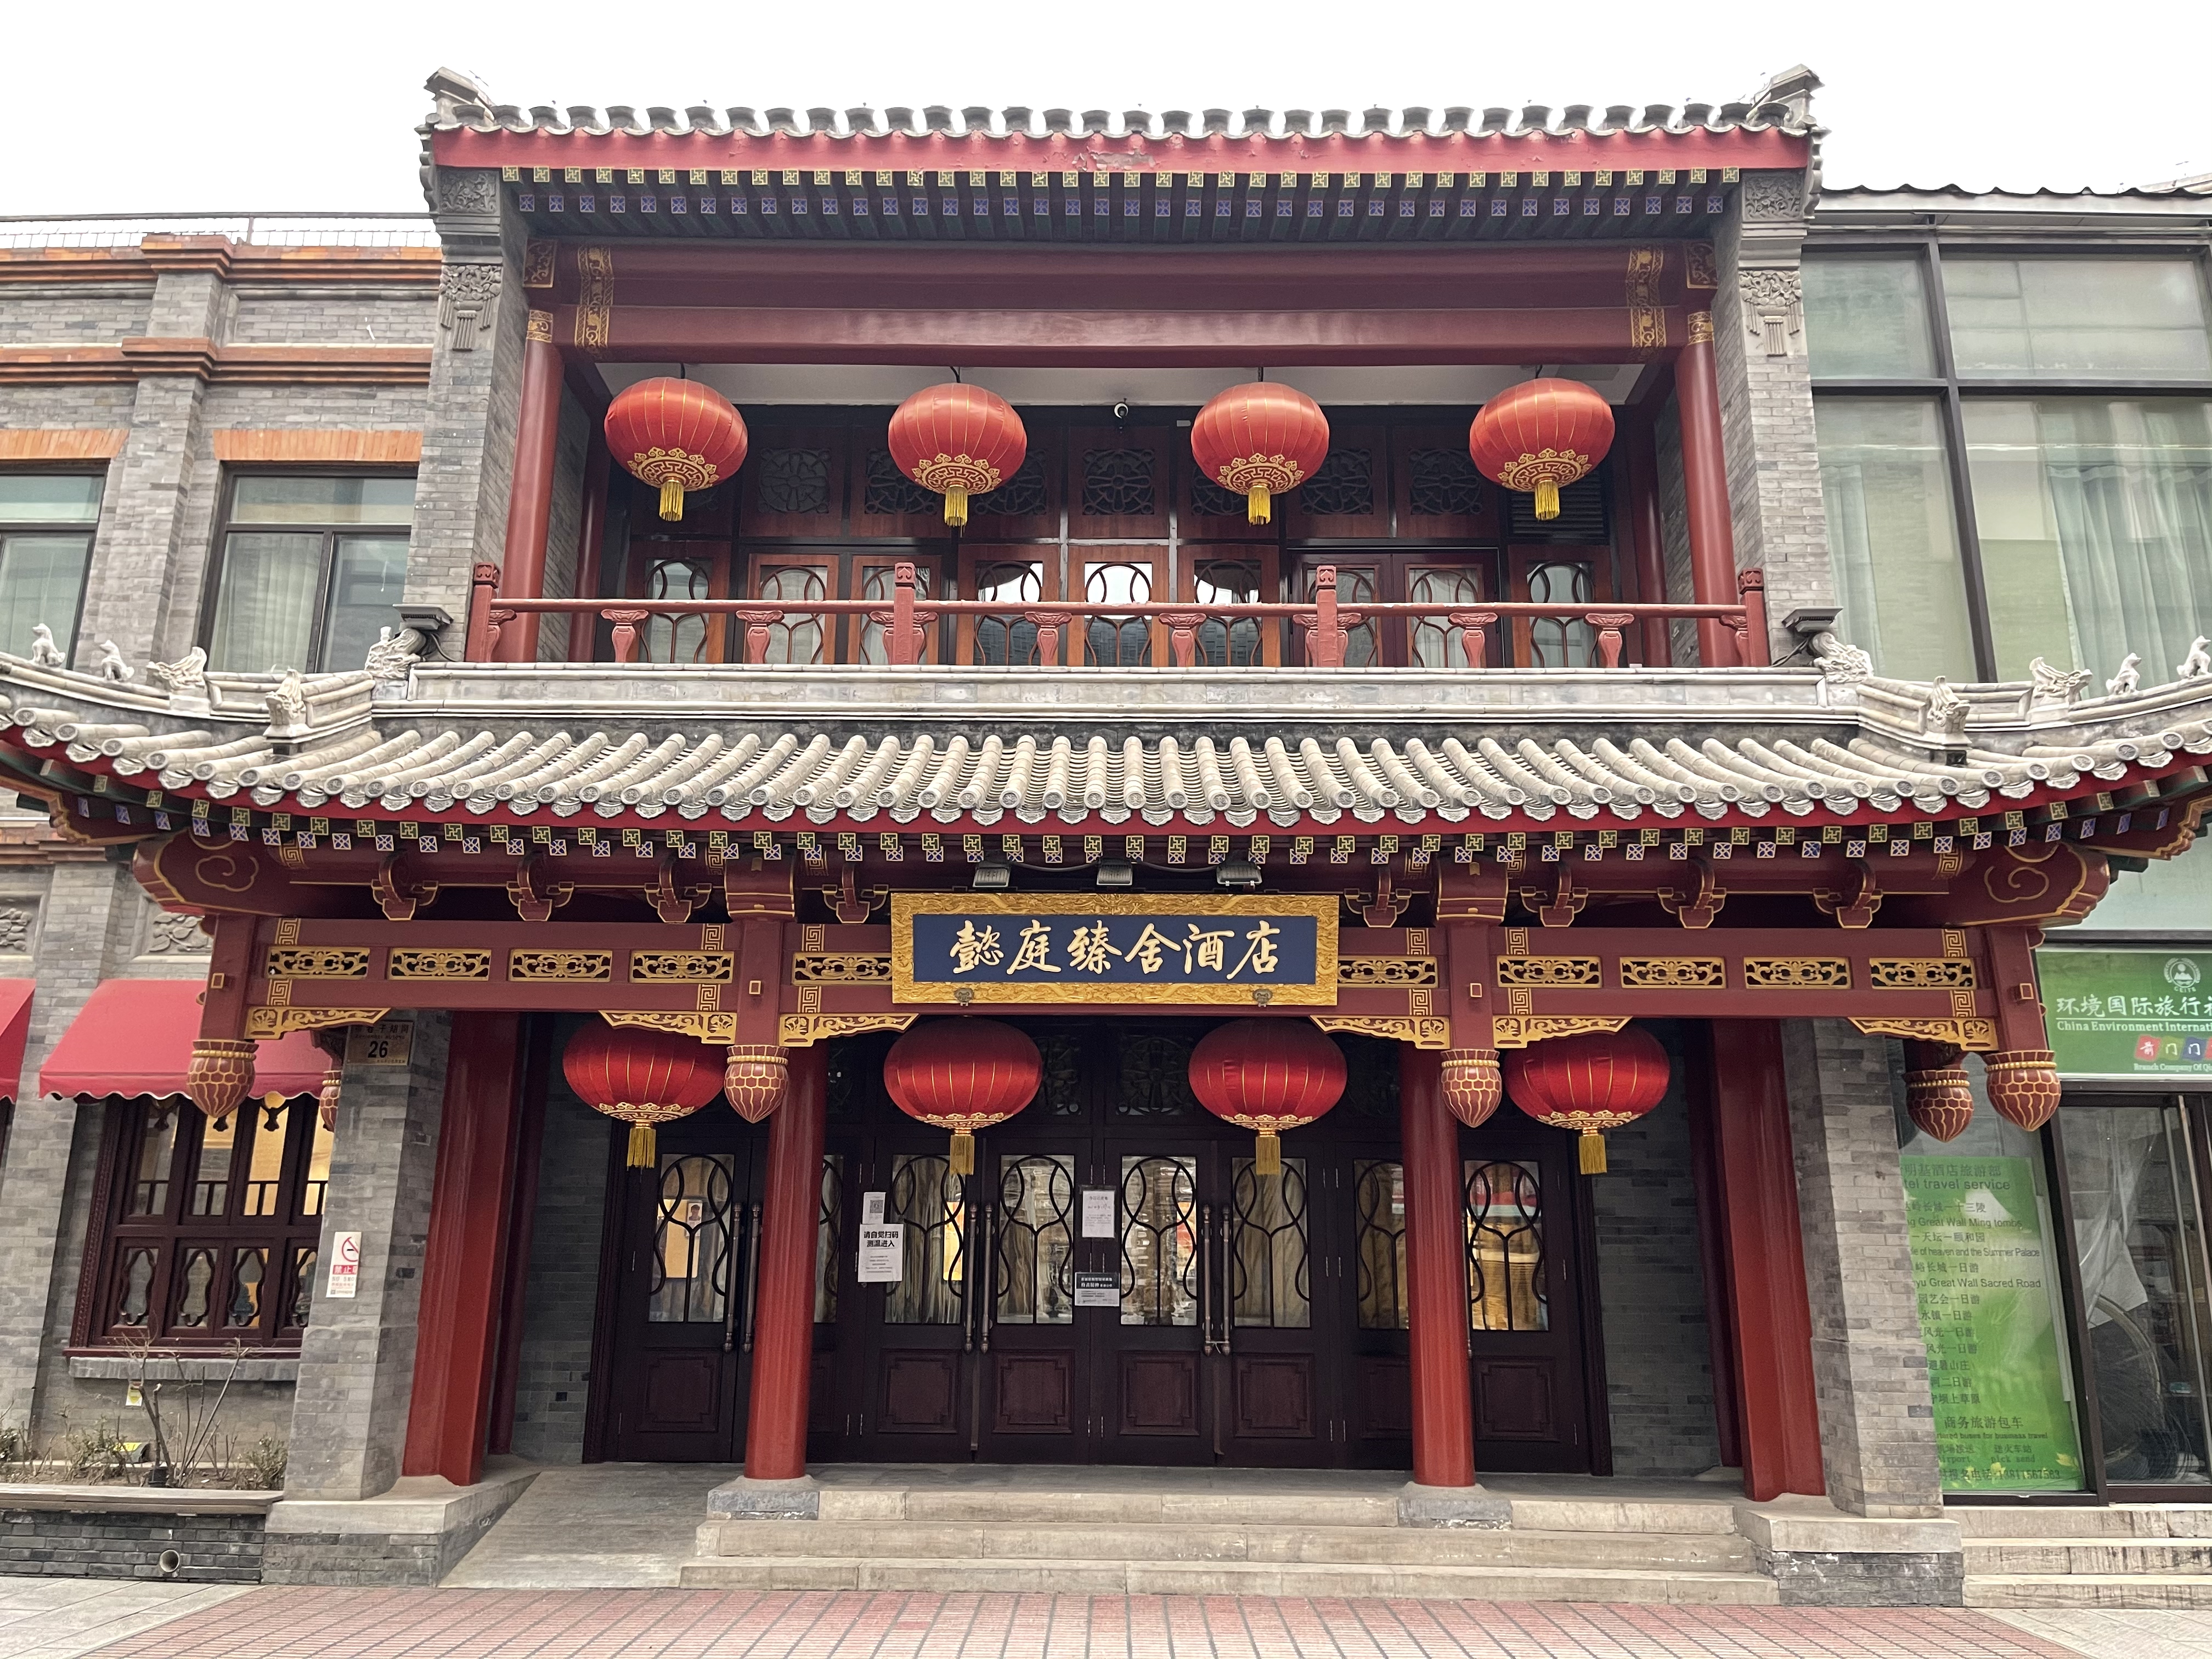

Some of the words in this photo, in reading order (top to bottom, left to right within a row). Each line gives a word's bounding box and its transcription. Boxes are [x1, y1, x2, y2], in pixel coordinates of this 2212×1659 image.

[950, 919, 1280, 980] 懿庭臻舍酒店
[2057, 1021, 2089, 1031] China
[2091, 1021, 2163, 1032] Environment
[368, 1041, 389, 1058] 26
[1924, 1179, 1960, 1190] travel
[1964, 1179, 2011, 1190] service
[1918, 1217, 1944, 1227] Great
[1946, 1217, 1967, 1227] Wall
[1969, 1218, 1991, 1229] Ming
[1994, 1218, 2023, 1228] tombs
[864, 1231, 899, 1239] 请自觉扫码
[1921, 1246, 1928, 1256] of
[1928, 1247, 1955, 1256] heaven
[1956, 1248, 1970, 1256] and
[1971, 1248, 1982, 1256] the
[1984, 1248, 2014, 1257] Summer
[2015, 1248, 2040, 1257] Palace
[1929, 1278, 1955, 1288] Great
[1957, 1278, 1978, 1288] Wall
[1980, 1278, 2013, 1288] Sacred
[2016, 1279, 2041, 1288] Road
[1944, 1415, 2024, 1429] 商务旅游包车
